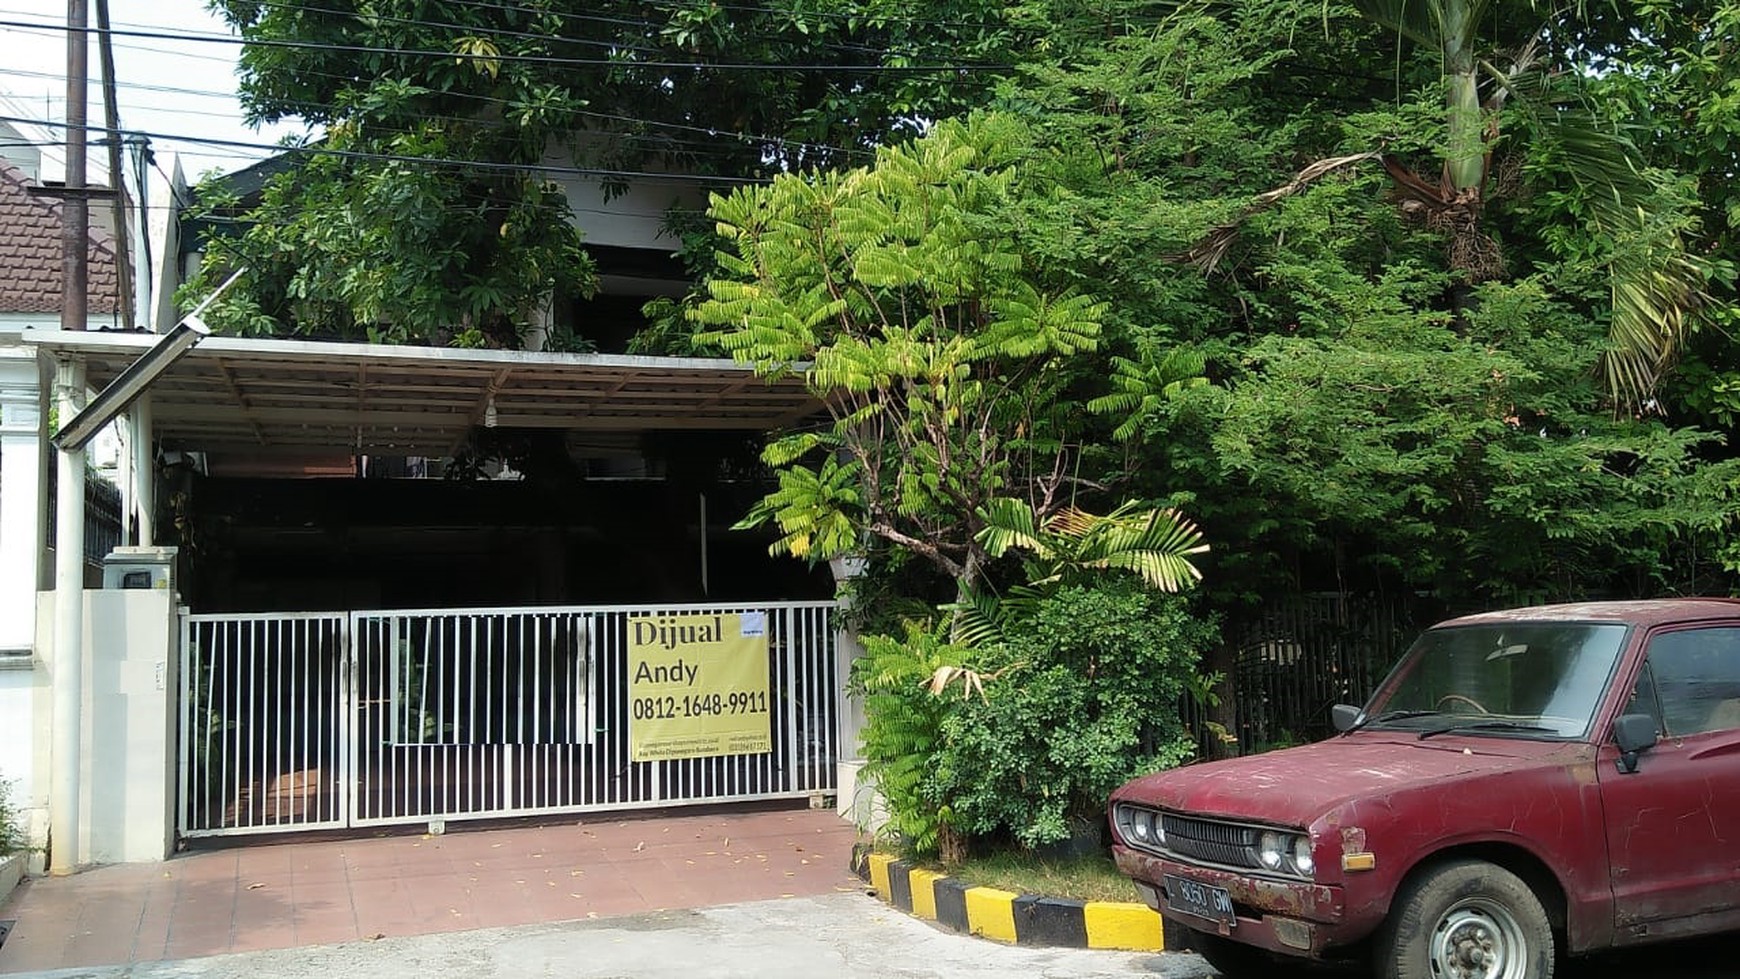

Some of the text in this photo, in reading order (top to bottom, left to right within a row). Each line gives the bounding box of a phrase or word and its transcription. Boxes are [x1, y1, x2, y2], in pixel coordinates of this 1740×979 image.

[633, 616, 723, 650] Dijual
[634, 659, 698, 686] Andy
[633, 690, 768, 720] 0812-1648-9911
